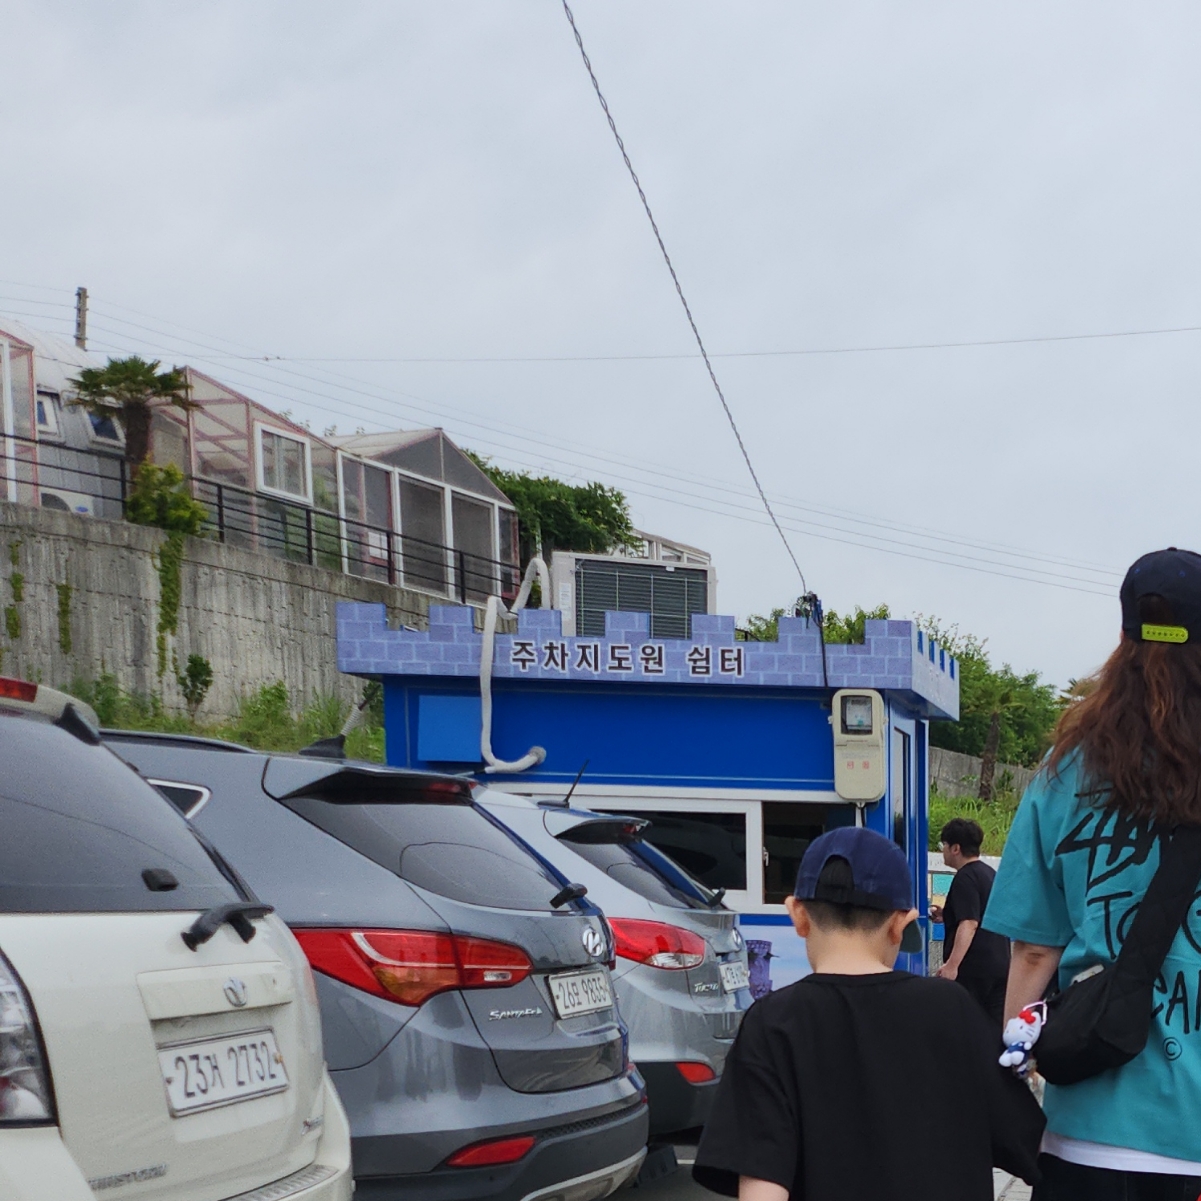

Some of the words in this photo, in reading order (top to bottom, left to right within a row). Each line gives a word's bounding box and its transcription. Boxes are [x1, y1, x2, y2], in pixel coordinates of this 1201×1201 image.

[511, 641, 665, 674] 주차지도원
[687, 646, 744, 676] 쉼터
[581, 976, 606, 1005] 9835
[227, 1040, 277, 1087] 2732
